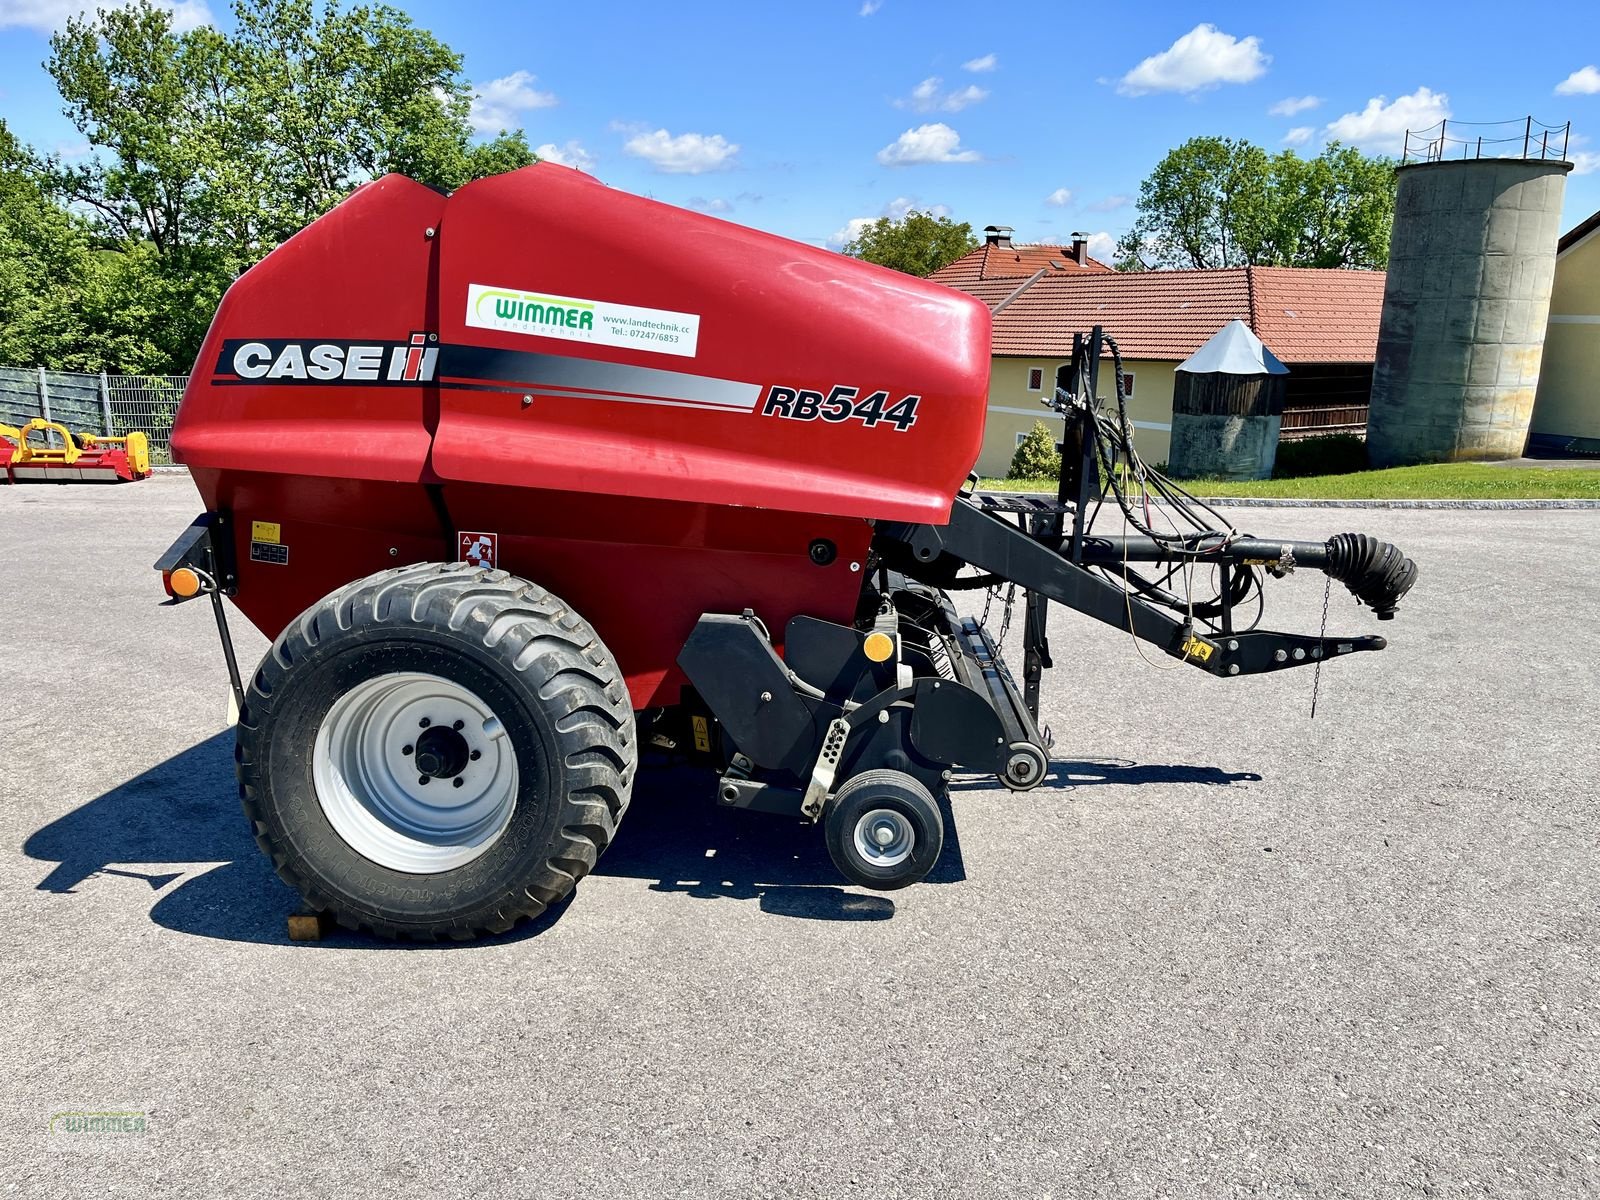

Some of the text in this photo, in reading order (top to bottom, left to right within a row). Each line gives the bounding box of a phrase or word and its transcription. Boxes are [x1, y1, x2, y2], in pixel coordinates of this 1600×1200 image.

[495, 298, 594, 331] WIMMER
[602, 314, 690, 334] www.landtechnik.cc
[611, 325, 679, 344] Tel.: 07247/6853
[233, 342, 384, 380] CASE
[761, 384, 922, 432] RB544
